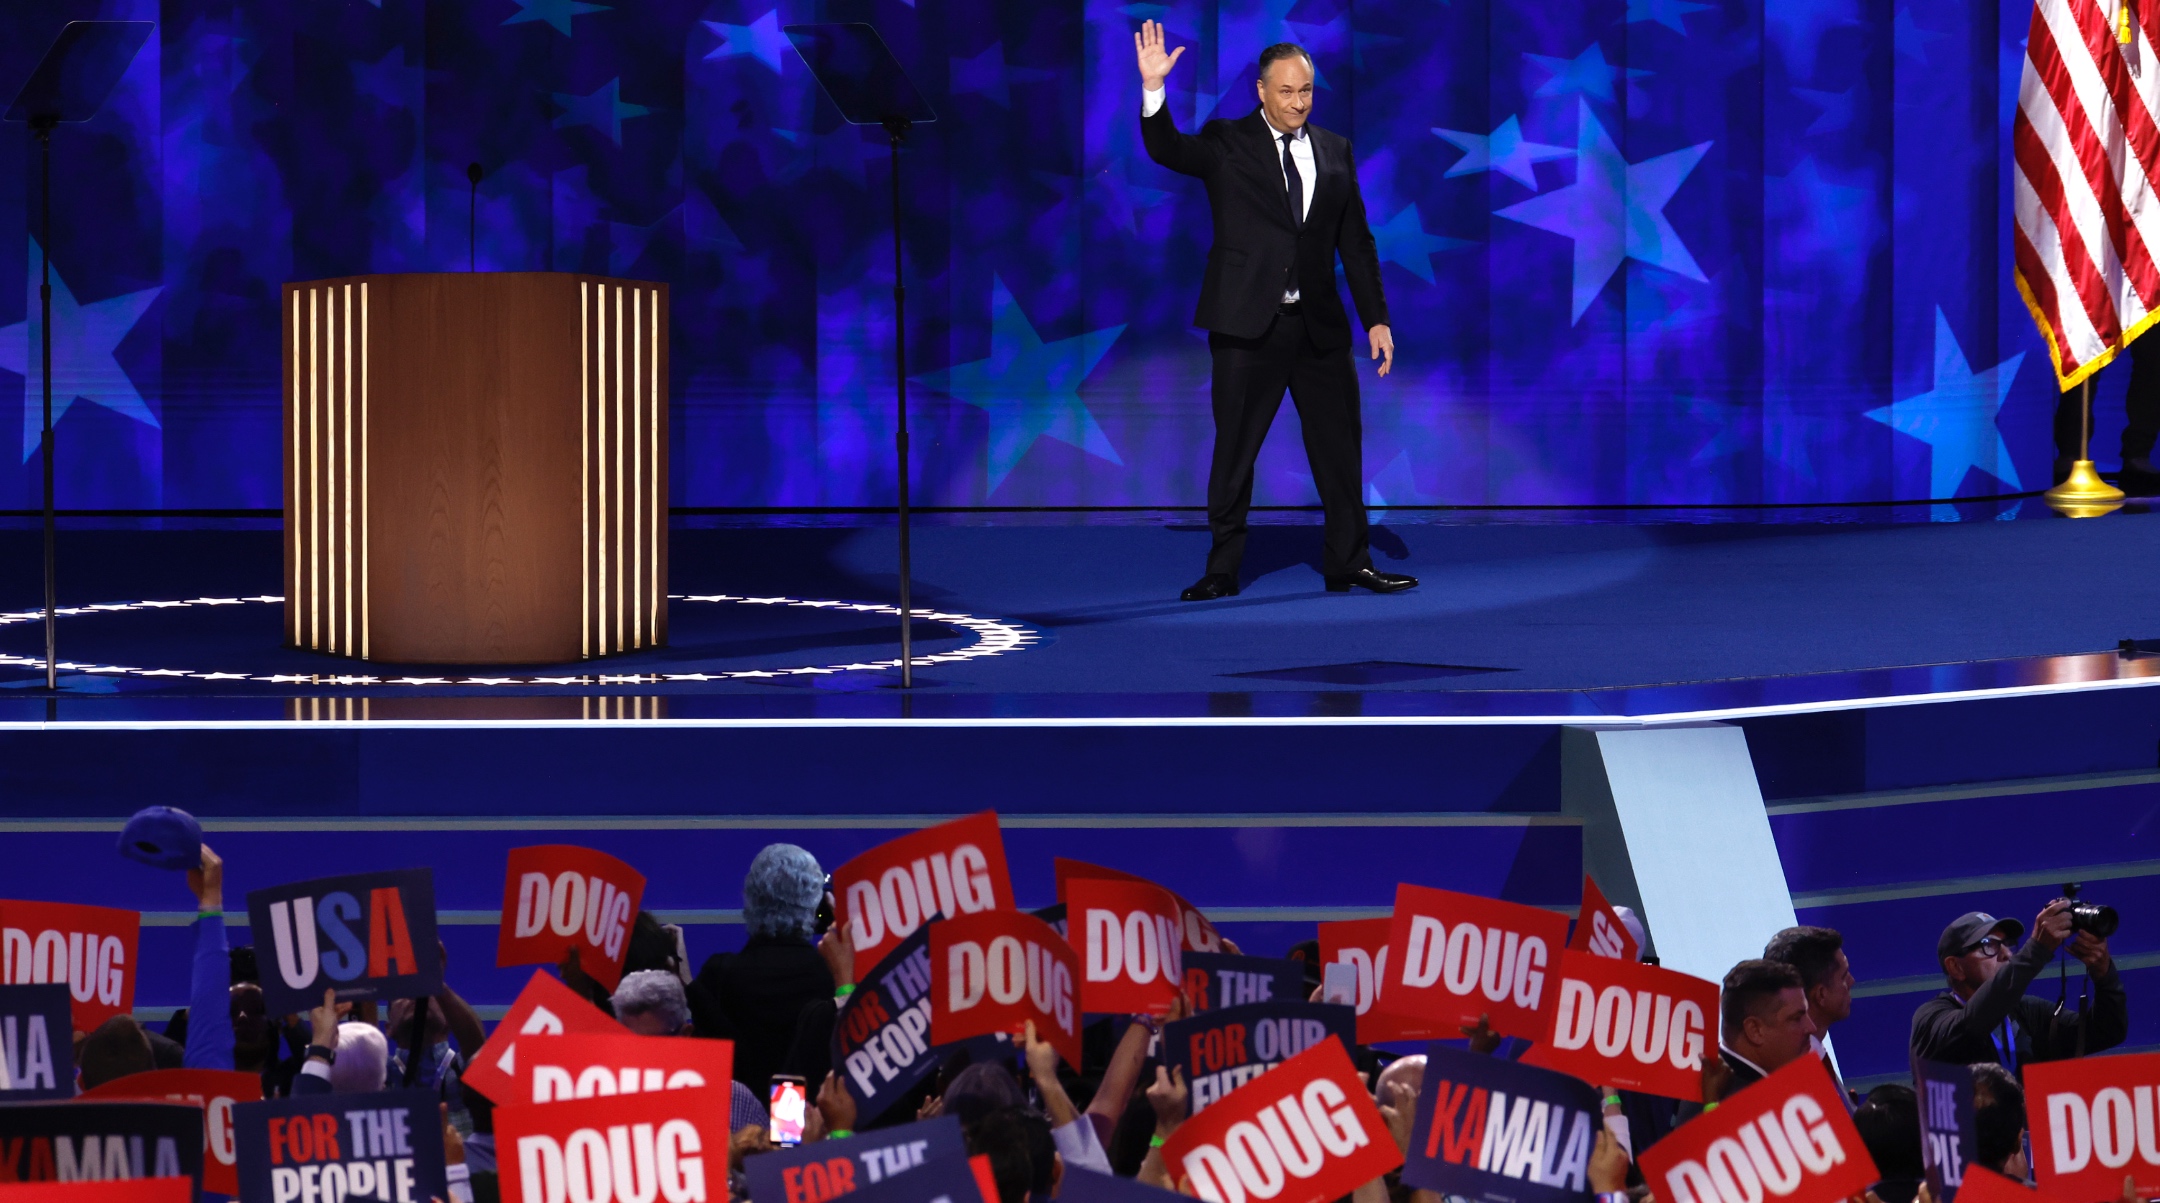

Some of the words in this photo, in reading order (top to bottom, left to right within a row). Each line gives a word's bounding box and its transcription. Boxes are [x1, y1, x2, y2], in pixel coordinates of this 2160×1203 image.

[269, 886, 418, 990] USA
[515, 871, 630, 963] DOUG
[847, 844, 996, 952] DOUG
[2, 927, 125, 1007] DOUG
[948, 935, 1074, 1037] DOUG
[1086, 908, 1182, 986] DOU
[1402, 915, 1548, 1011] DOUG
[845, 998, 932, 1098] PEOP
[1189, 1023, 1248, 1076] FOR
[1553, 977, 1705, 1072] DOUG
[268, 1113, 340, 1165] FOR
[345, 1107, 414, 1159] THE
[1182, 1078, 1370, 1203] DOUG
[1425, 1079, 1591, 1193] KAMALA
[1665, 1094, 1846, 1203] DOUG
[1926, 1079, 1959, 1131] THE
[2047, 1085, 2160, 1175] DOU
[517, 1118, 707, 1203] DOUG
